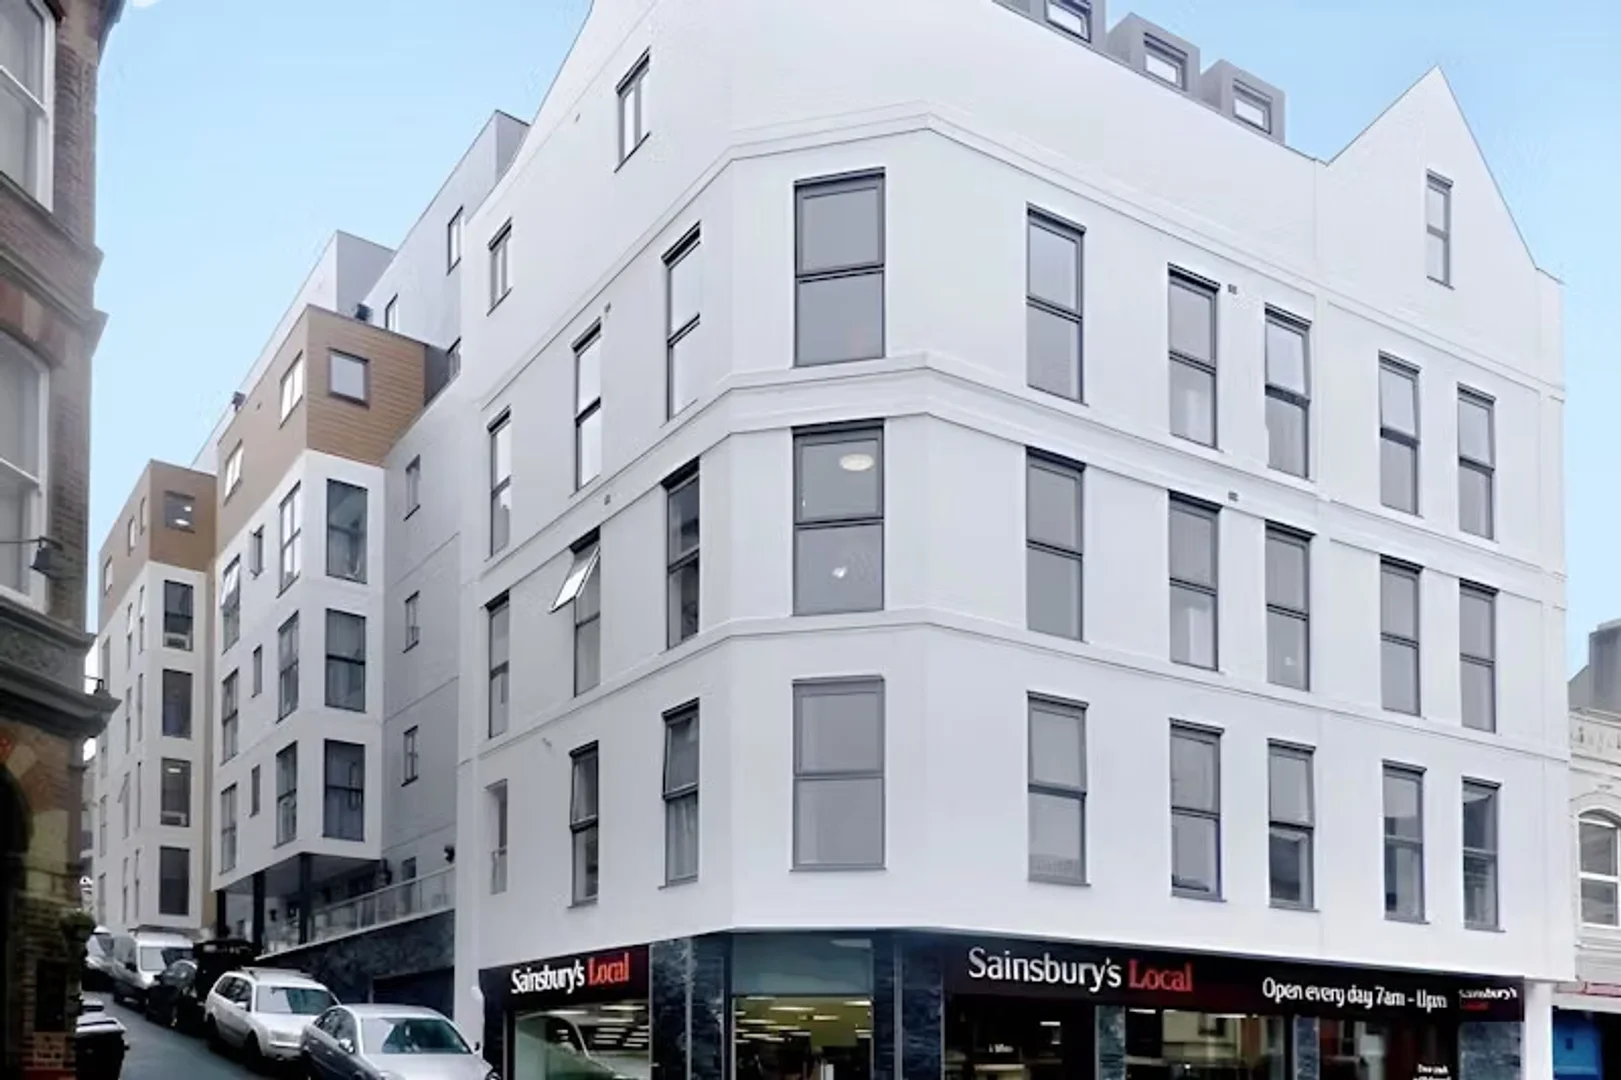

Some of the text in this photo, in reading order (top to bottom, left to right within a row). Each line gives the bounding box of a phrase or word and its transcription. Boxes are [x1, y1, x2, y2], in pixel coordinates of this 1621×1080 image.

[510, 951, 629, 994] Sainsbury's Local
[968, 946, 1193, 992] Sainsbury's Local
[1262, 976, 1303, 1004] Open
[1305, 985, 1345, 1008] every
[1347, 984, 1373, 1009] day
[1374, 985, 1406, 1007] 7am
[1416, 988, 1448, 1013] 11pm
